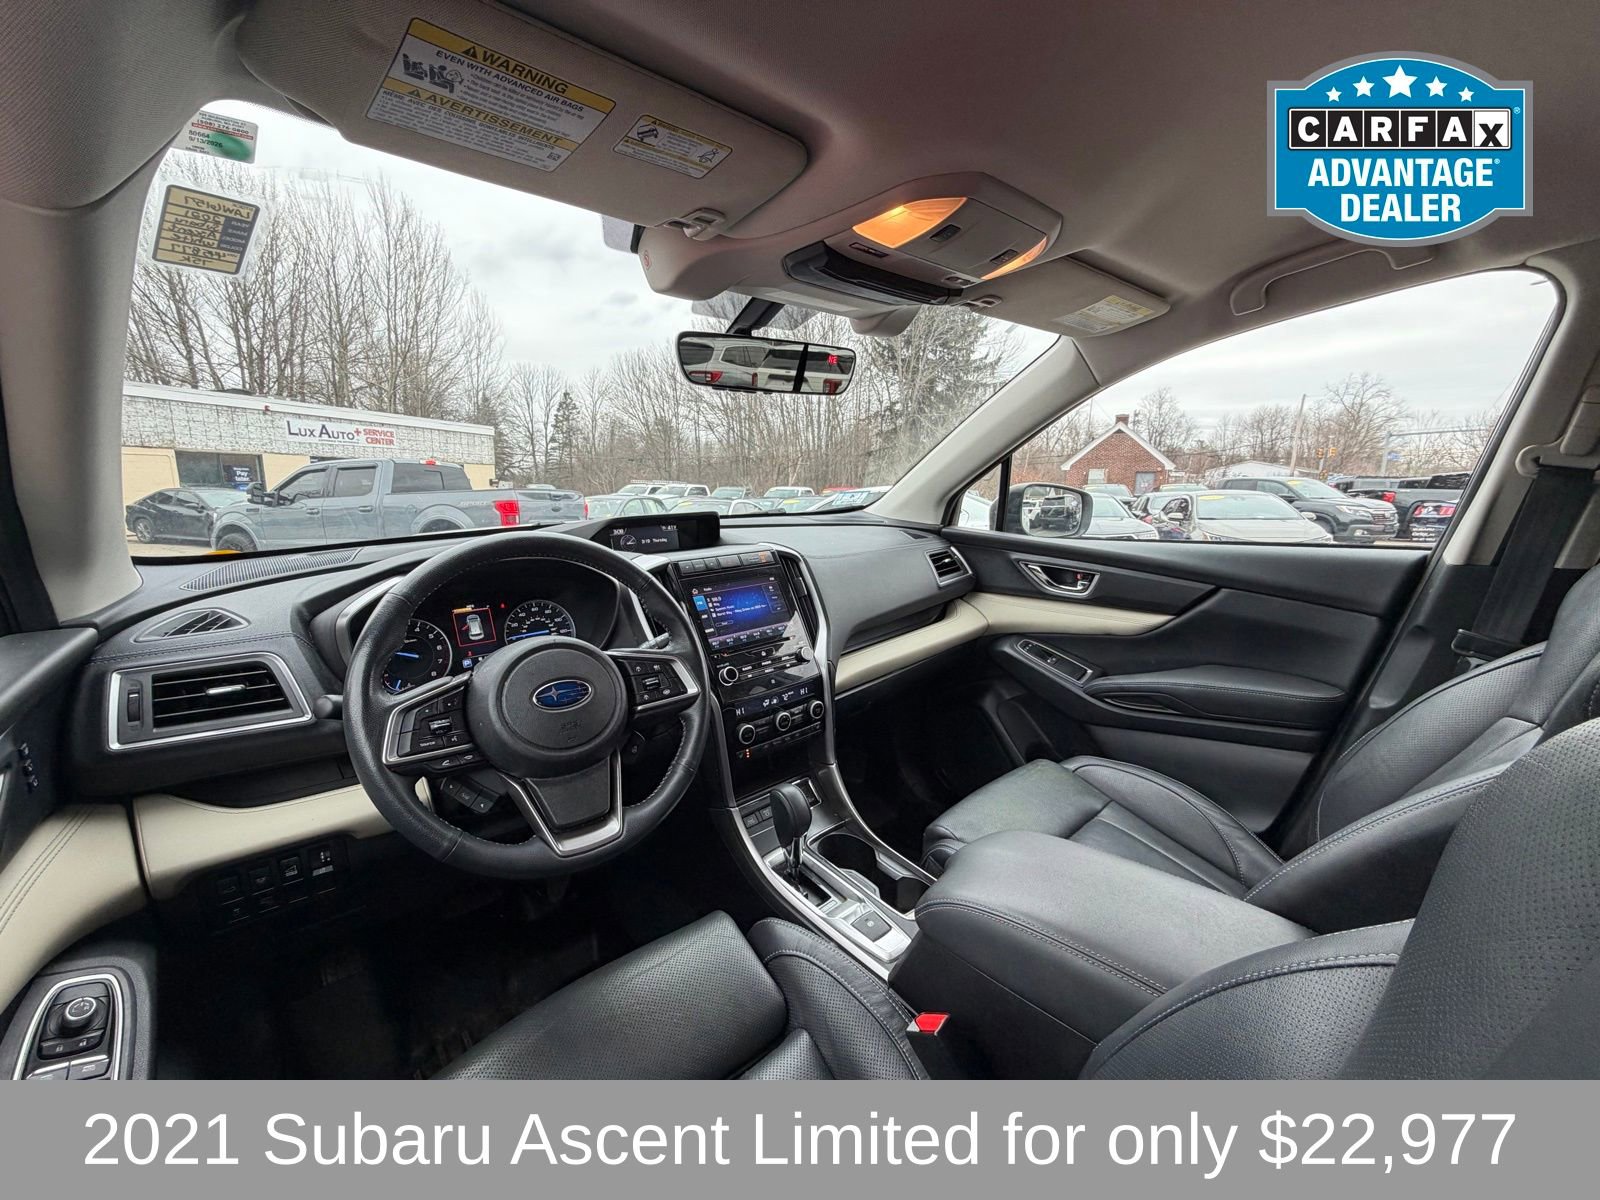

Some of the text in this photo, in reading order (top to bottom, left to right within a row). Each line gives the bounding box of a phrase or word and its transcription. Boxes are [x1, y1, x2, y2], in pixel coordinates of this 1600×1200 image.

[436, 50, 464, 66] EVEN
[467, 61, 492, 76] WITH
[494, 73, 543, 97] ADVANCED
[544, 94, 560, 103] AIR
[561, 100, 584, 112] BAGS
[481, 50, 568, 94] WARNING
[425, 94, 562, 144] AVERTISSEMENT
[363, 428, 395, 438] SERVICE
[365, 437, 395, 446] CENTER
